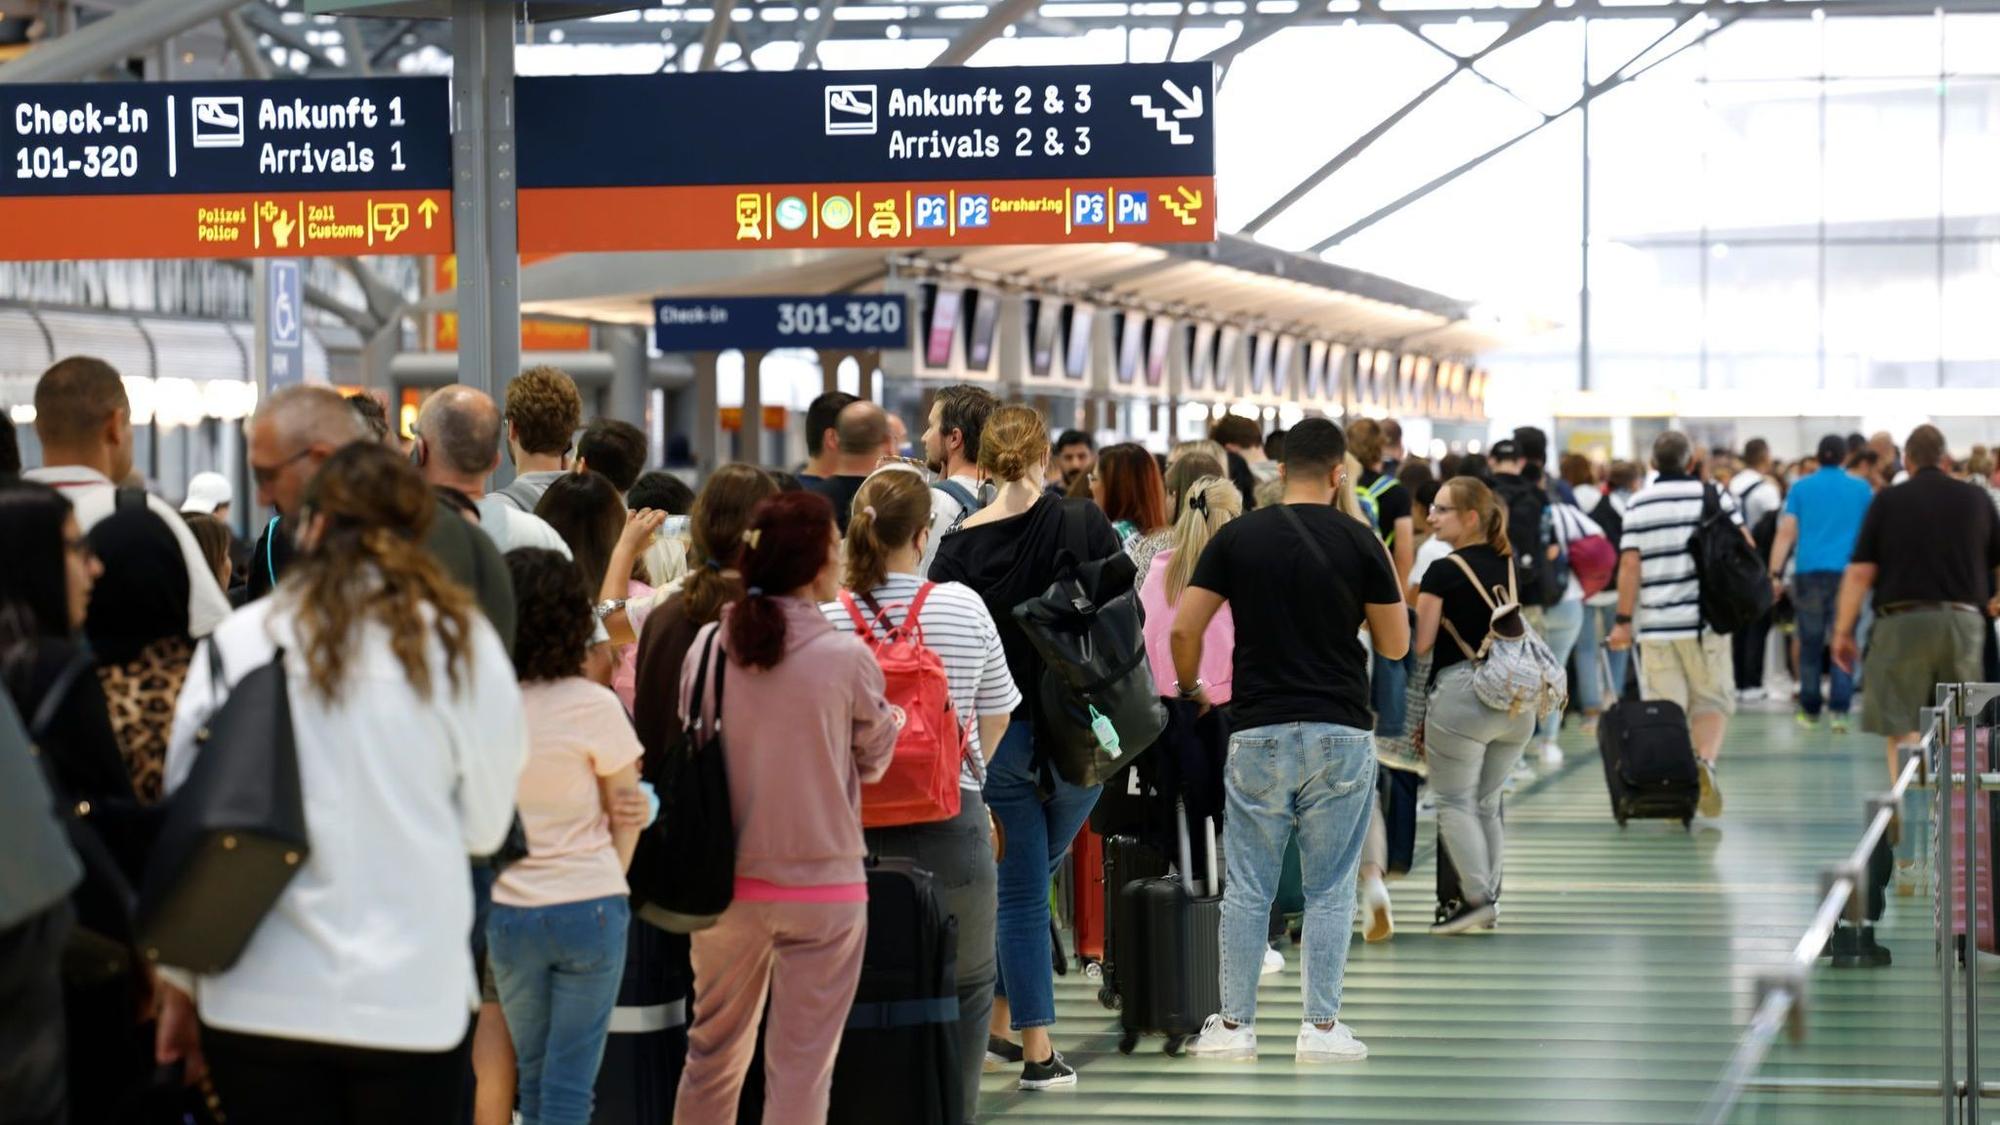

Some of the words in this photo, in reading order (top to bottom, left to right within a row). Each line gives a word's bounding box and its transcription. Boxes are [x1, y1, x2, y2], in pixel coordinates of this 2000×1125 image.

[258, 96, 378, 130] Ankunft
[389, 96, 406, 127] 1
[888, 86, 1003, 117] Ankunft
[1014, 85, 1032, 115] 2
[1043, 84, 1064, 114] &
[1074, 84, 1092, 114] 3
[15, 101, 149, 135] Check-in
[259, 141, 375, 174] Arrivals
[390, 140, 406, 171] 1
[888, 128, 1000, 159] Arrivals
[1015, 127, 1033, 157] 2
[1043, 126, 1065, 156] &
[1074, 126, 1092, 156] 3
[16, 144, 138, 179] 101-320
[198, 207, 247, 224] Polizei
[308, 205, 335, 221] Zoll
[990, 196, 1064, 214] Carsharing
[198, 225, 239, 242] Police
[308, 223, 365, 239] Customs
[660, 305, 728, 324] Check-in
[777, 301, 901, 335] 301-320
